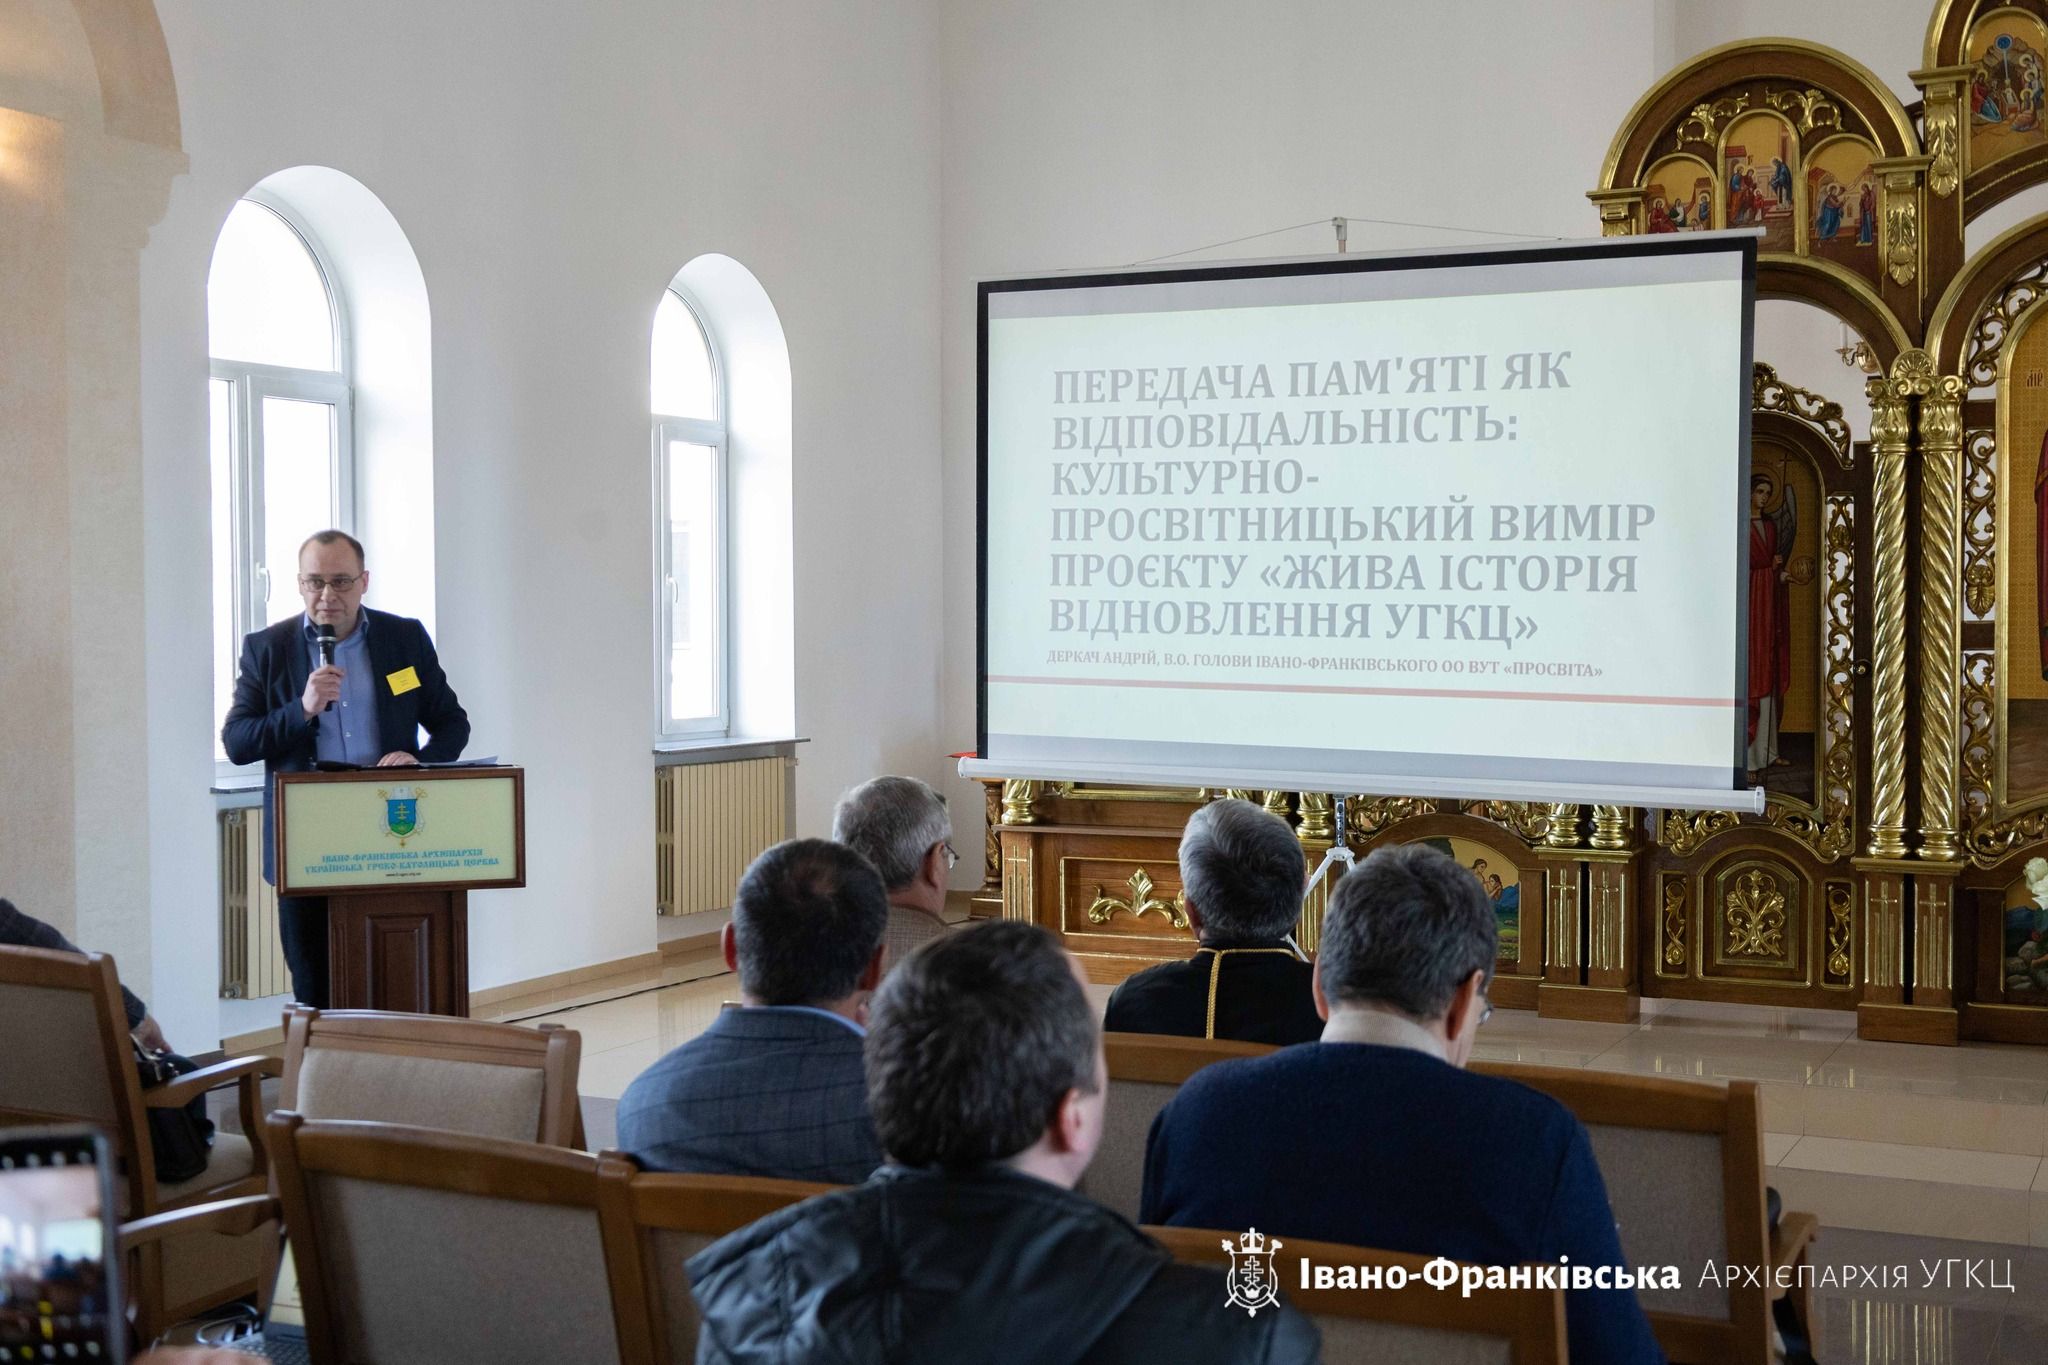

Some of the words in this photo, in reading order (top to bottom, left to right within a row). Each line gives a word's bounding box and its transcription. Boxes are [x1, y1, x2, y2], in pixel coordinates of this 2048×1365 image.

[1053, 364, 1276, 409] ПЕРЕДАЧА
[1287, 354, 1488, 398] ПАМ'ЯТІ
[1500, 351, 1572, 390] ЯК
[1051, 405, 1518, 458] ВІДПОВІДАЛЬНІСТЬ:
[1051, 458, 1320, 497] КУЛЬТУРНО-
[1050, 494, 1475, 550] ПРОСВІТНИЦЬКИЙ
[1489, 504, 1655, 542] ВИМІР
[1050, 553, 1249, 589] ПРОЄКТУ
[1259, 554, 1427, 591] «ЖИВА
[1438, 555, 1639, 593] ІСТОРІЯ
[1049, 599, 1372, 641] ВІДНОВЛЕННЯ
[1384, 603, 1539, 650] УГКЦ»
[1046, 650, 1101, 665] ДЕРКАЧ
[1103, 650, 1161, 667] АНДРІЙ,
[1163, 652, 1190, 667] В.О.
[1193, 653, 1252, 669] ГОЛОВИ
[1255, 654, 1438, 673] ІВАНО-ФРАНКІВСЬКОГО
[1441, 659, 1465, 674] ОО
[1468, 661, 1500, 675] ВУТ
[1503, 661, 1603, 678] «ПРОСВІТА»
